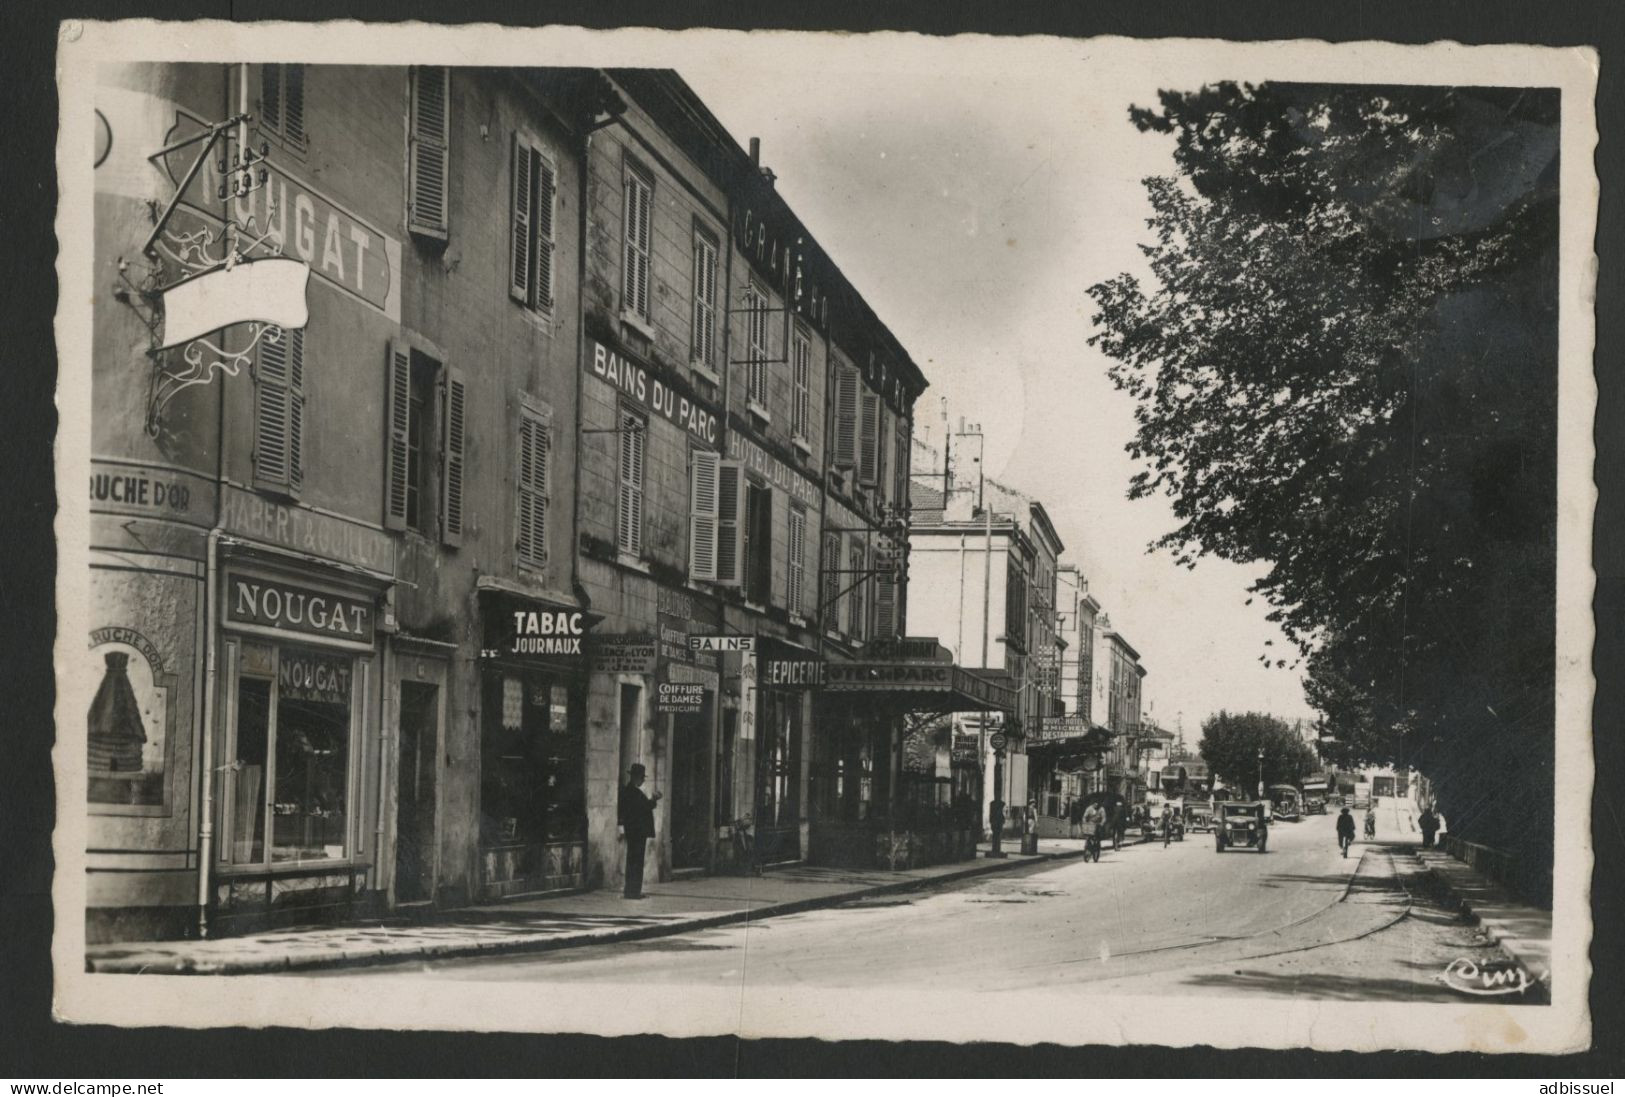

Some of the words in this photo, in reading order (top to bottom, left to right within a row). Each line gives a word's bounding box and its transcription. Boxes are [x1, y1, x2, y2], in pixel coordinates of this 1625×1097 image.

[202, 137, 370, 291] NOUGAT
[594, 341, 648, 402] BAINS
[652, 379, 674, 418] DU
[679, 397, 717, 444] PARC
[731, 428, 771, 478] HOTEL
[774, 458, 791, 489] DU
[792, 471, 821, 508] PARC
[153, 481, 190, 511] D'OR
[303, 518, 317, 551] &
[236, 581, 368, 635] NOUGAT
[514, 611, 584, 635] TABAC
[91, 629, 142, 647] RUCHE
[511, 637, 582, 655] JOURNAUX
[690, 638, 752, 651] BAINS
[631, 647, 656, 657] LYON
[280, 660, 349, 693] NOUGAT
[772, 661, 827, 685] EPICERIE
[894, 667, 948, 682] PARC
[658, 683, 705, 695] COIFFURE
[660, 695, 670, 704] DE
[671, 695, 703, 705] DAMES
